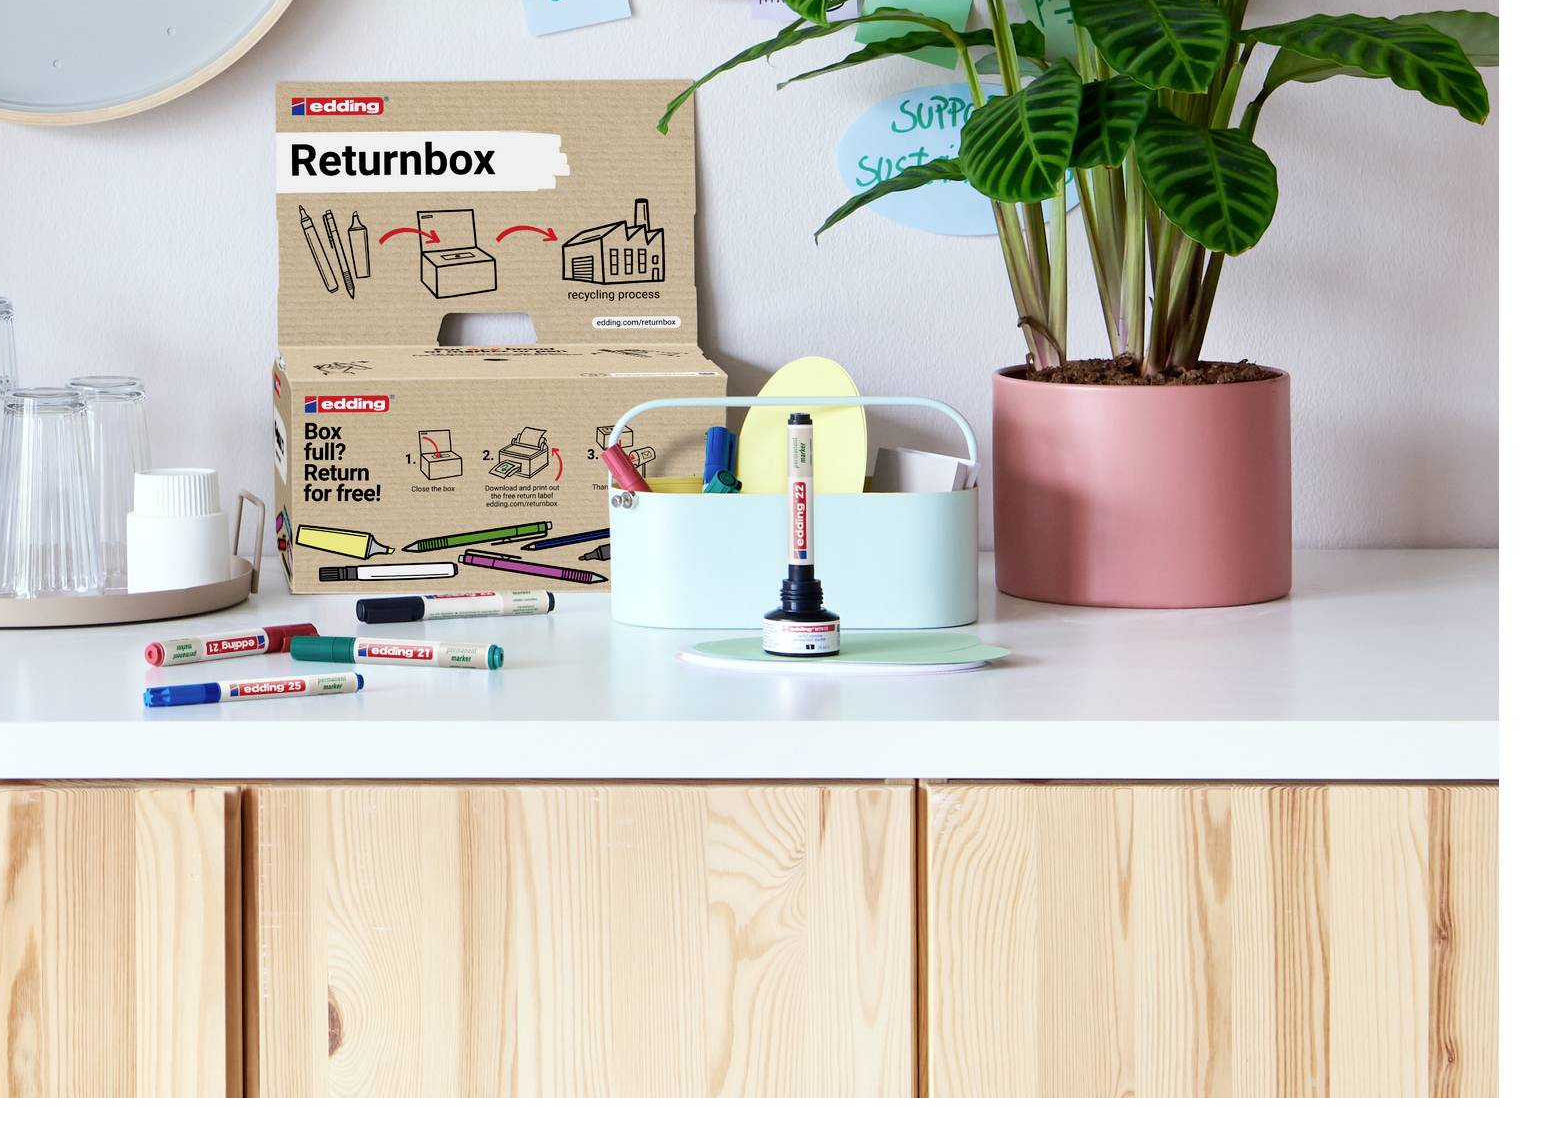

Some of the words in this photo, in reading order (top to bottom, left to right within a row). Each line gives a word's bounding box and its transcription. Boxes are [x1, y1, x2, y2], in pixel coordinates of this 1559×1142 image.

[310, 98, 380, 115] edding
[290, 141, 497, 177] Returnbox
[567, 289, 615, 302] recycling
[618, 290, 661, 302] process
[596, 317, 677, 328] edding.com/returnbox
[321, 397, 387, 413] edding
[303, 422, 343, 441] Box
[303, 442, 346, 461] full?
[481, 449, 494, 463] 2.
[587, 448, 600, 461] 3.
[404, 453, 417, 466] 1.
[303, 463, 370, 482] Return
[303, 484, 337, 503] for
[341, 484, 383, 503] free!
[411, 485, 431, 494] Close
[432, 485, 442, 493] the
[443, 485, 456, 493] box
[484, 484, 518, 493] Download
[519, 484, 531, 492] and
[532, 484, 547, 494] print
[549, 484, 560, 492] out
[490, 492, 501, 500] the
[502, 492, 514, 500] free
[515, 492, 537, 500] return
[538, 491, 554, 499] label
[795, 485, 804, 499] 22
[486, 500, 558, 509] edding.com/returnbox
[795, 503, 806, 547] edding
[209, 643, 219, 653] 21
[221, 639, 255, 651] edding
[371, 645, 416, 659] edding
[417, 647, 431, 658] 21
[451, 655, 473, 663] marker
[244, 682, 285, 694] edding
[288, 681, 302, 692] 25
[322, 682, 344, 691] marker
